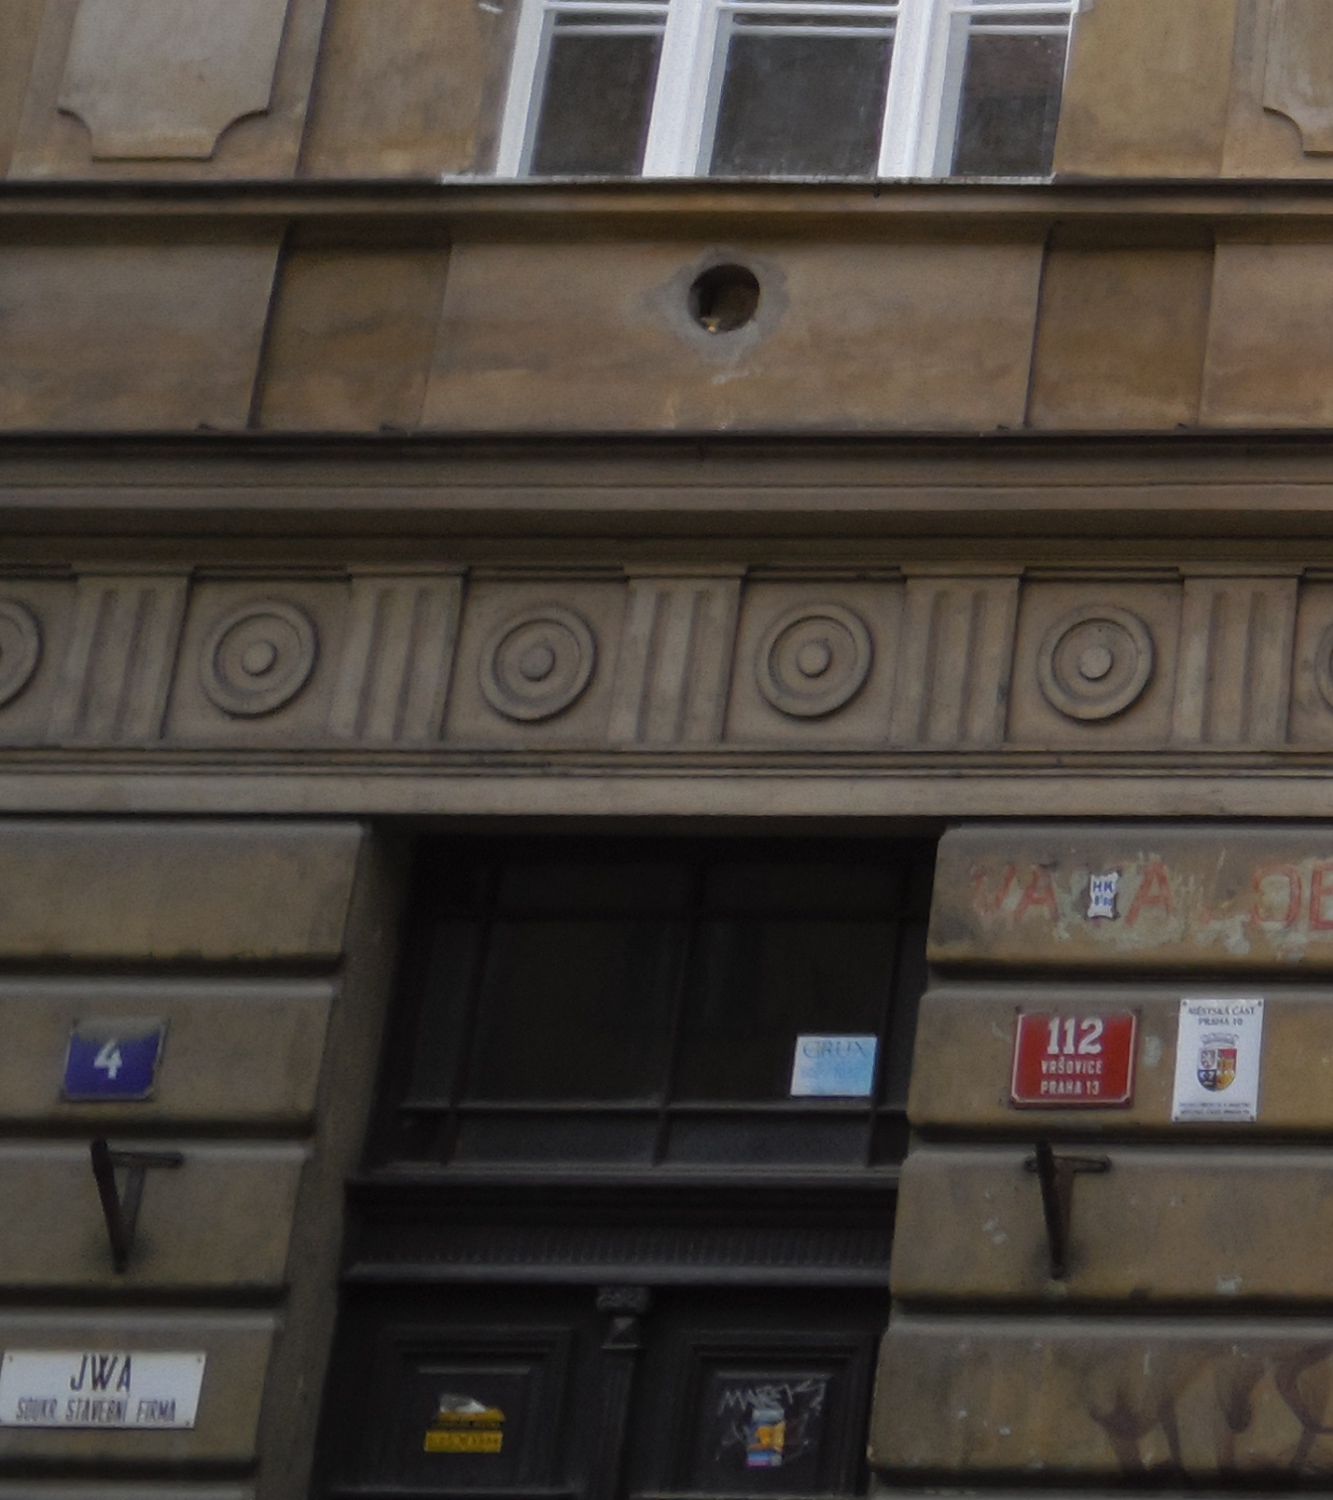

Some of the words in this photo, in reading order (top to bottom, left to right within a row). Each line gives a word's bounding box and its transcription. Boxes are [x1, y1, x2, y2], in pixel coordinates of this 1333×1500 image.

[1198, 1017, 1229, 1026] PRAHA
[1047, 1017, 1104, 1055] 112
[94, 1040, 123, 1080] 4
[1041, 1056, 1103, 1074] VRŠOVICE
[1040, 1080, 1082, 1095] PRAHA
[1086, 1080, 1100, 1095] 13
[69, 1353, 132, 1392] JWA
[136, 1399, 177, 1423] FIRMA
